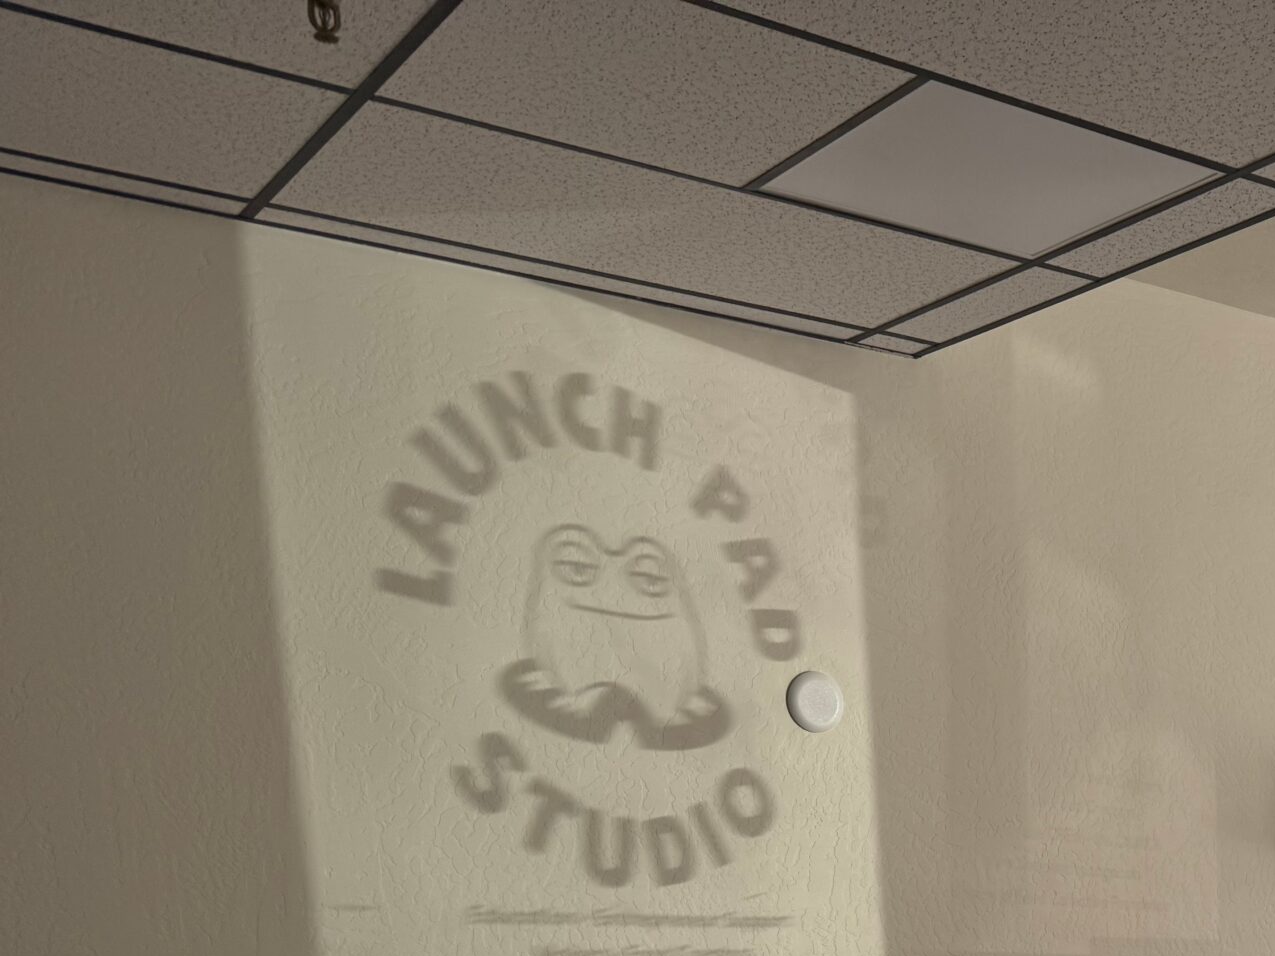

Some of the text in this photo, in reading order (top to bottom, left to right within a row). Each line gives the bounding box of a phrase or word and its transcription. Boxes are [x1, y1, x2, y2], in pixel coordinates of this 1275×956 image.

[374, 370, 803, 661] LAUNCH PAD
[450, 731, 776, 887] STUDIO
